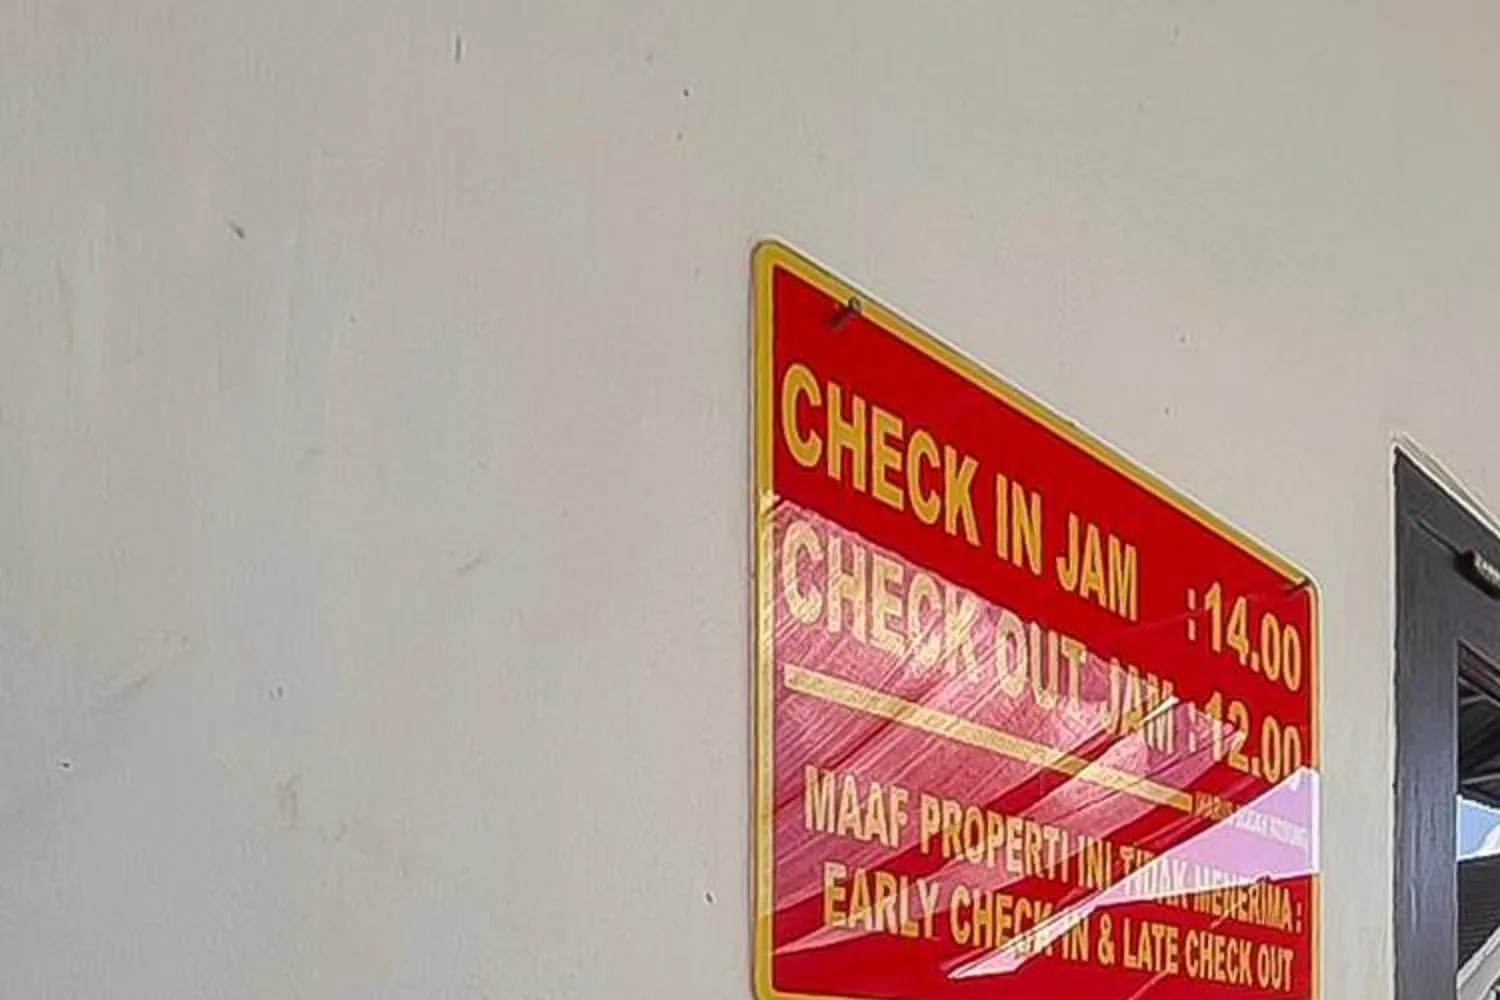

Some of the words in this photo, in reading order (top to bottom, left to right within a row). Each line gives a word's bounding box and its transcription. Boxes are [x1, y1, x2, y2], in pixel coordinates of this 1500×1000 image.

[782, 363, 981, 546] CHECK
[997, 472, 1042, 575] IN
[1056, 513, 1137, 622] JAM
[782, 520, 982, 683] CHECK
[996, 610, 1087, 716] OUT
[1105, 657, 1175, 752] JAM
[804, 764, 908, 847] MAAF
[921, 794, 1068, 883] PROPERTI
[1078, 835, 1111, 890] INI
[823, 861, 940, 939] EARLY
[951, 885, 1053, 956] CHECK
[1062, 914, 1088, 961] IN
[1098, 914, 1114, 964] &
[1124, 918, 1178, 974] LATE
[1185, 929, 1252, 986] CHECK
[1257, 944, 1293, 991] OUT
